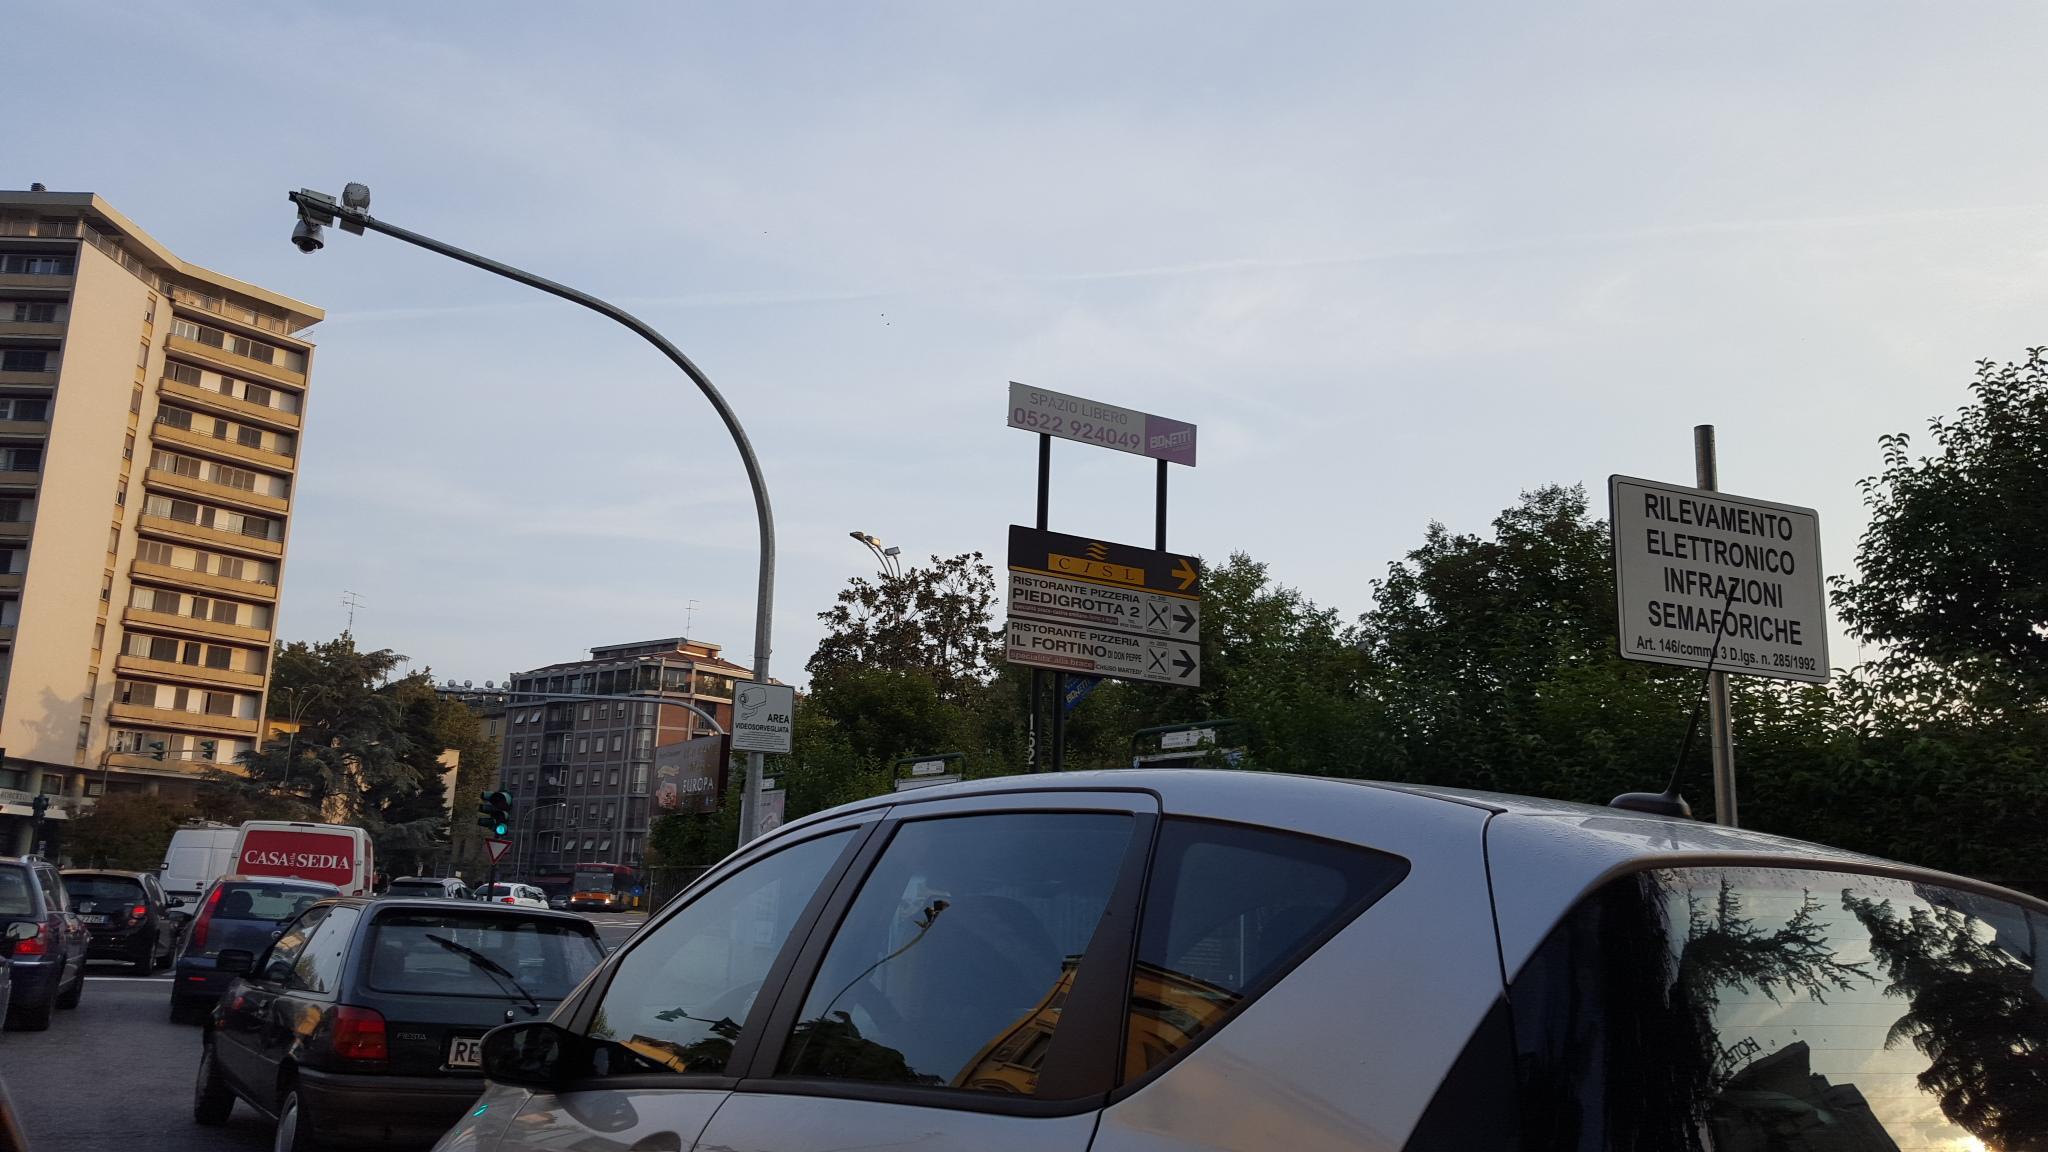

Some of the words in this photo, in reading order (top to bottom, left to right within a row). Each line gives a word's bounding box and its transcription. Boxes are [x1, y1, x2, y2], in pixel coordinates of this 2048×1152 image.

[1029, 392, 1078, 413] SPAZIO
[1081, 404, 1128, 425] LIBERO
[1013, 407, 1063, 433] 0522
[1070, 420, 1141, 449] 924049
[1645, 493, 1793, 541] RILEVAMENTO
[1646, 528, 1795, 576] ELETTRONICO
[1013, 575, 1087, 595] RISTORANTE
[1090, 588, 1140, 604] PIZZERIA
[1664, 567, 1783, 609] INFRAZIONI
[1012, 588, 1125, 616] PIEDIGROTTA
[1129, 606, 1140, 618] 2
[1011, 622, 1087, 640] RISTORANTE
[1089, 632, 1140, 648] PIZZERIA
[1648, 600, 1803, 646] SEMAFORICHE
[1011, 634, 1026, 647] IL
[1032, 636, 1107, 658] FORTINO
[1113, 651, 1125, 661] DON
[1125, 652, 1143, 663] PEPPE
[1636, 635, 1656, 651] Art.
[1720, 646, 1728, 660] 3
[1730, 647, 1759, 666] D.lgs.
[1761, 654, 1771, 665] n.
[1773, 653, 1816, 671] 285/1992
[1095, 664, 1117, 673] CHIUSO
[735, 722, 790, 733] VIDEOSORVEGLIATA
[767, 713, 790, 724] AREA
[682, 776, 714, 792] EUROPA
[244, 849, 289, 866] CASA
[296, 853, 351, 870] SEDIA
